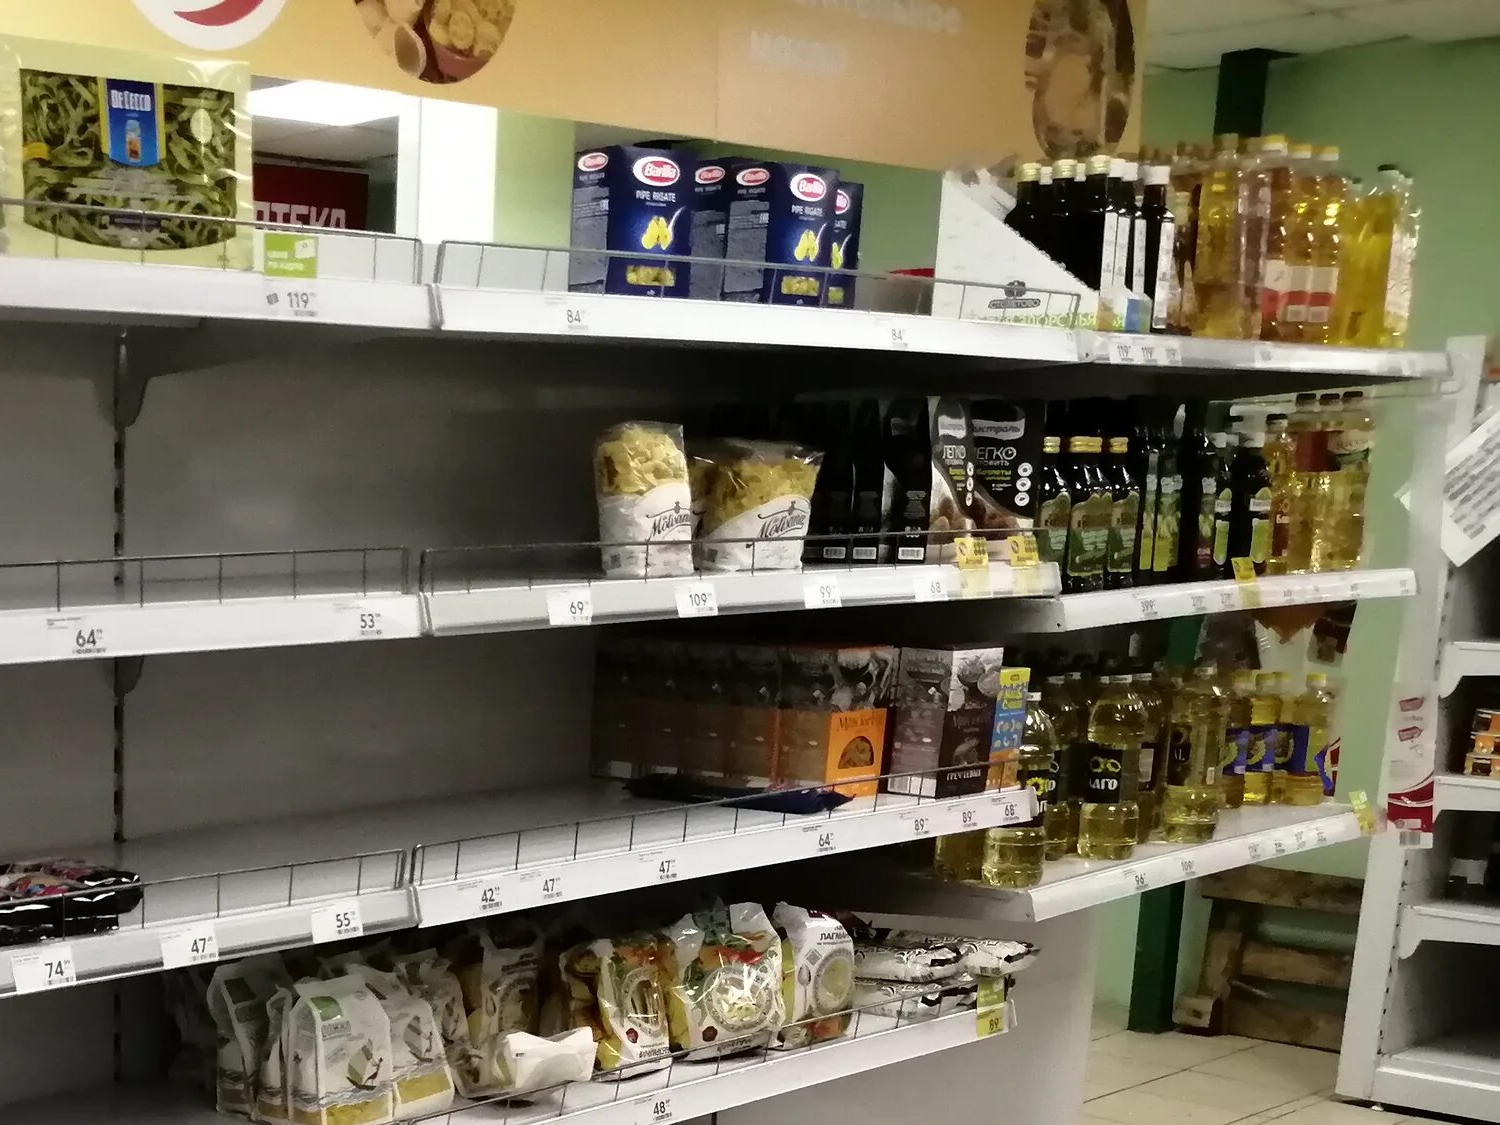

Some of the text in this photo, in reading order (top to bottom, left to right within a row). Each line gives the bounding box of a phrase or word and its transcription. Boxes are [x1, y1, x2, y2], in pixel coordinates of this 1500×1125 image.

[253, 200, 346, 230] ПТЕКА
[286, 292, 309, 309] 119
[566, 308, 582, 324] 84
[976, 446, 1017, 460] ЕГКО
[689, 593, 708, 607] 109
[570, 601, 584, 615] 69
[360, 613, 375, 629] 53
[76, 629, 98, 647] 64
[962, 811, 973, 824] 89
[1004, 804, 1015, 817] 68
[914, 819, 925, 832] 89
[818, 833, 832, 849] 64
[659, 860, 671, 874] 47
[543, 878, 556, 893] 47
[1134, 874, 1145, 885] 96
[481, 888, 496, 903] 42
[336, 913, 351, 929] 55
[191, 938, 207, 955] 47
[44, 960, 64, 979] 74
[653, 1101, 667, 1116] 48
